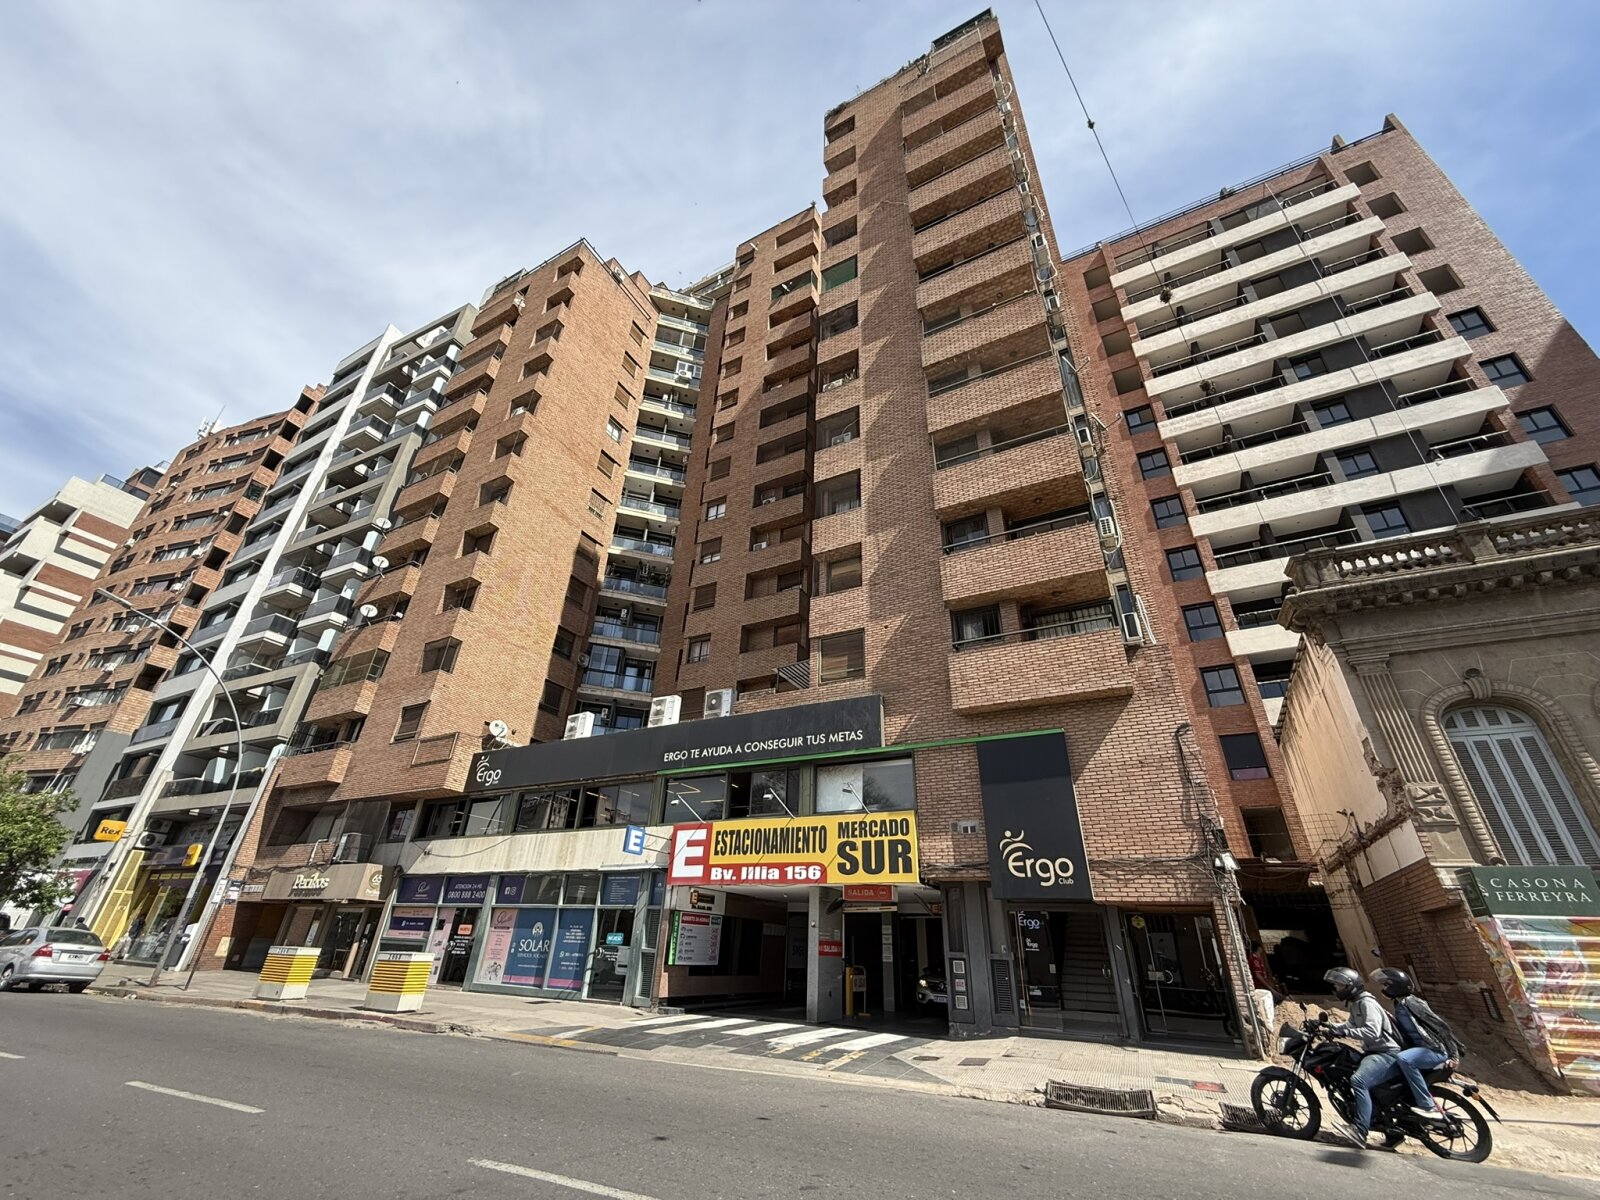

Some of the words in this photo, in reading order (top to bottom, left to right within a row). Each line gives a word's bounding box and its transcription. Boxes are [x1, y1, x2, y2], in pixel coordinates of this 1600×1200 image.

[664, 751, 688, 762] ERGO
[690, 749, 700, 758] TE
[701, 745, 733, 757] AYUDA
[734, 744, 742, 753] A
[744, 737, 803, 752] CONSEGUIR
[806, 733, 825, 745] TUS
[828, 730, 864, 743] METAS
[476, 767, 502, 786] Ergo
[100, 826, 121, 835] Rex
[837, 817, 910, 838] MERCADO
[628, 827, 643, 852] E
[713, 825, 827, 856] ESTACIONAMIENTO
[671, 828, 708, 878] E
[837, 839, 913, 875] SUR
[710, 867, 736, 881] Bv.
[741, 866, 782, 880] Illia
[784, 865, 822, 880] 156
[1008, 852, 1074, 886] Ergo
[1489, 878, 1586, 889] CASONA
[447, 891, 461, 899] 0800
[472, 890, 485, 898] 2400
[1495, 891, 1593, 902] FERREYRA
[1019, 917, 1040, 929] Ergo
[518, 939, 550, 952] SOLAR
